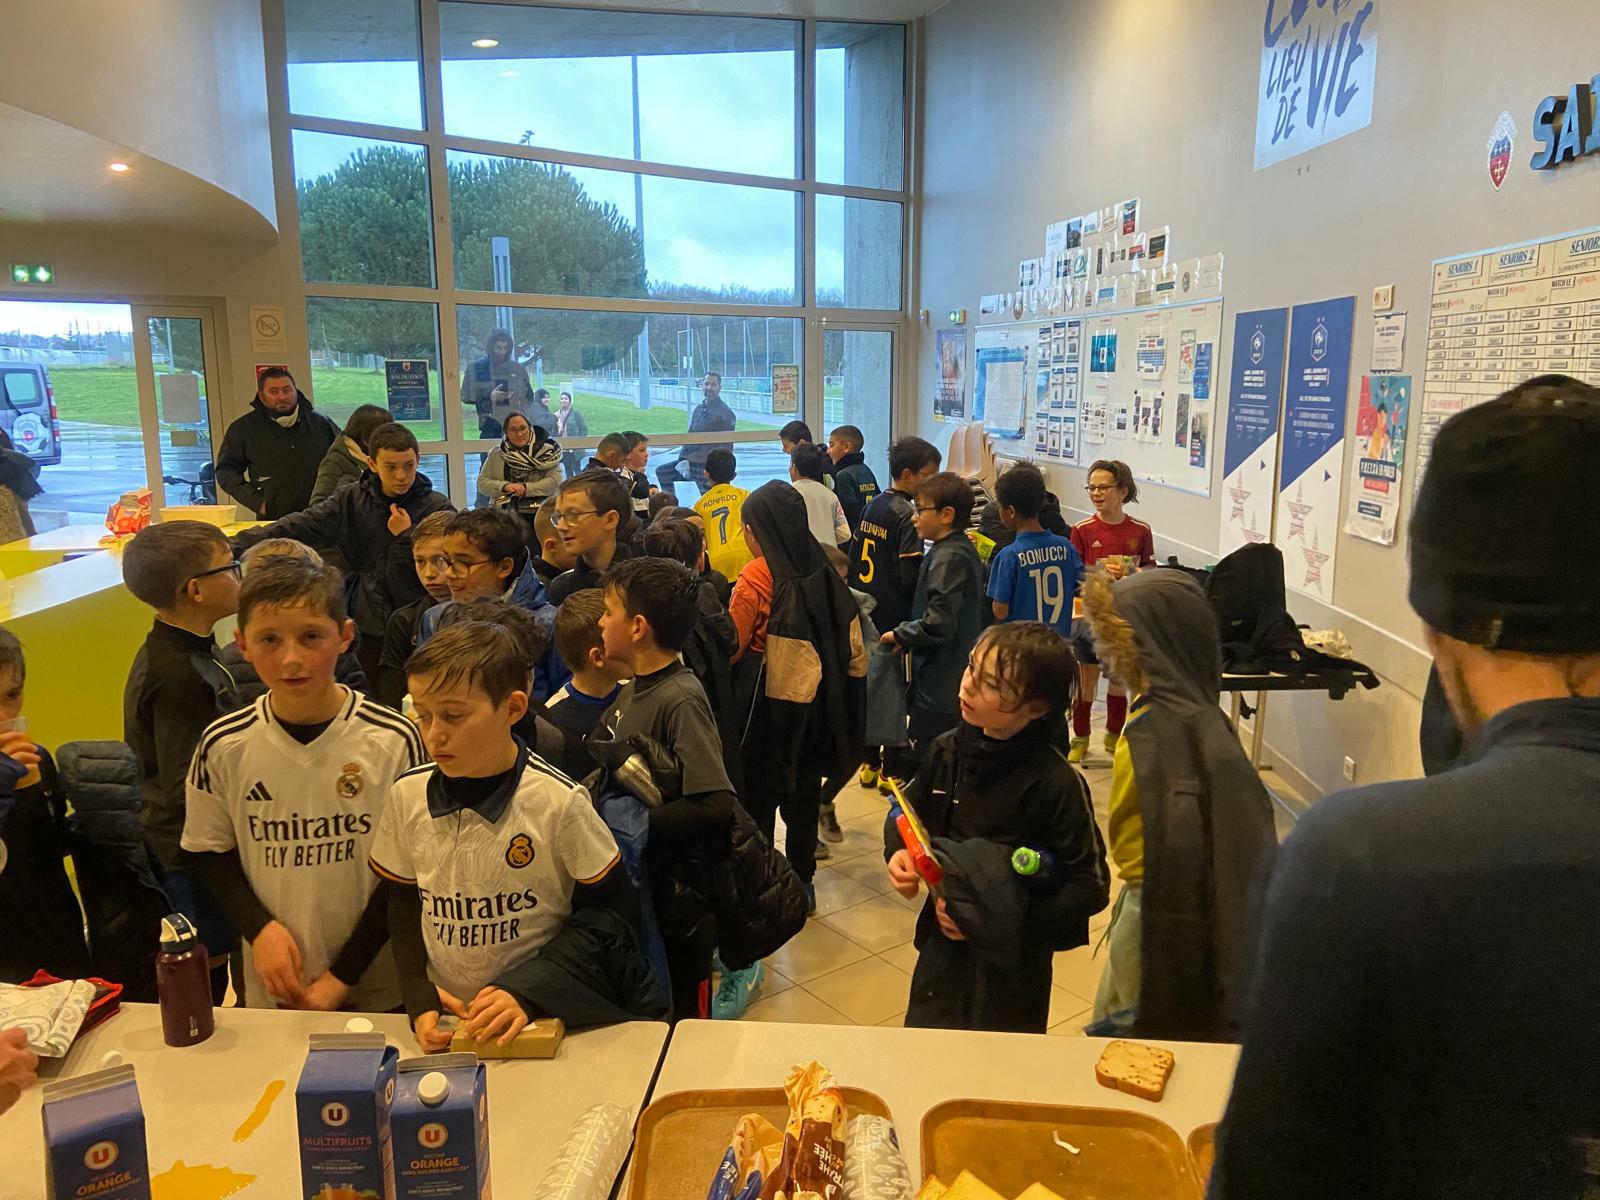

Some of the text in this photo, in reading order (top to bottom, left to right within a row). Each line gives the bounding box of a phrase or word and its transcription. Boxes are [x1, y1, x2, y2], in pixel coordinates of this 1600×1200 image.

[1266, 24, 1311, 99] LIEU
[1306, 1, 1373, 136] VIE
[1271, 86, 1301, 145] DE
[1448, 260, 1473, 275] SENIORS
[1499, 251, 1527, 266] SENIORS
[703, 494, 737, 509] RONALDO
[711, 506, 730, 545] 7
[858, 538, 876, 584] 5
[1018, 546, 1067, 567] BONUCCI
[1028, 565, 1064, 624] 19
[248, 812, 372, 842] Emirates
[265, 838, 355, 868] FLY BETTER
[460, 918, 520, 947] BETTER
[328, 1108, 343, 1122] U
[303, 1135, 373, 1147] MULTIFRUITS
[425, 1129, 440, 1143] U
[92, 1147, 110, 1165] U
[410, 1156, 460, 1170] ORANGE
[76, 1171, 132, 1196] ORANGE
